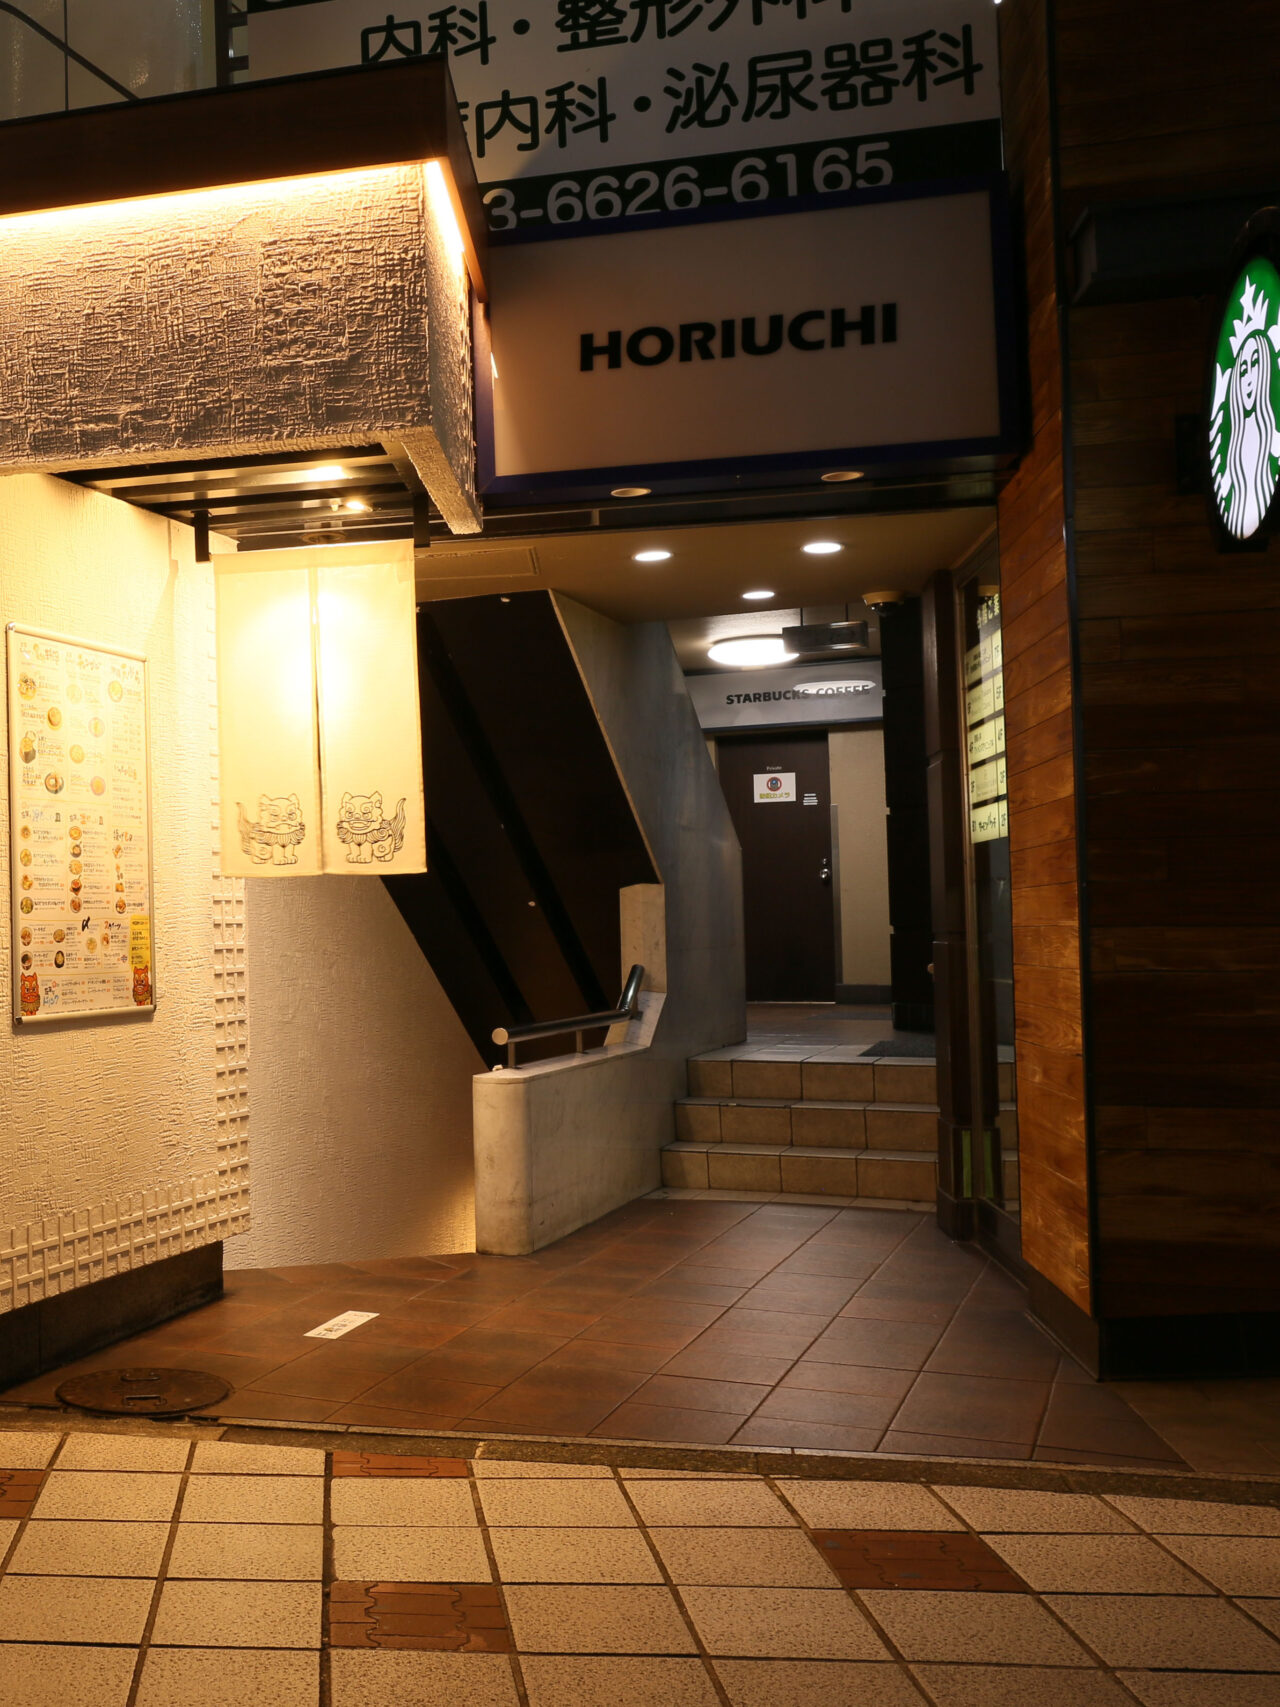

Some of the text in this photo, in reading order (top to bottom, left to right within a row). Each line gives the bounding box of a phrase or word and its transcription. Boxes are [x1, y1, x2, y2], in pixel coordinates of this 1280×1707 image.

[458, 24, 983, 159] 内科・泌尿器科
[578, 303, 898, 372] HORIUCHI
[726, 688, 811, 705] STARBUCKS
